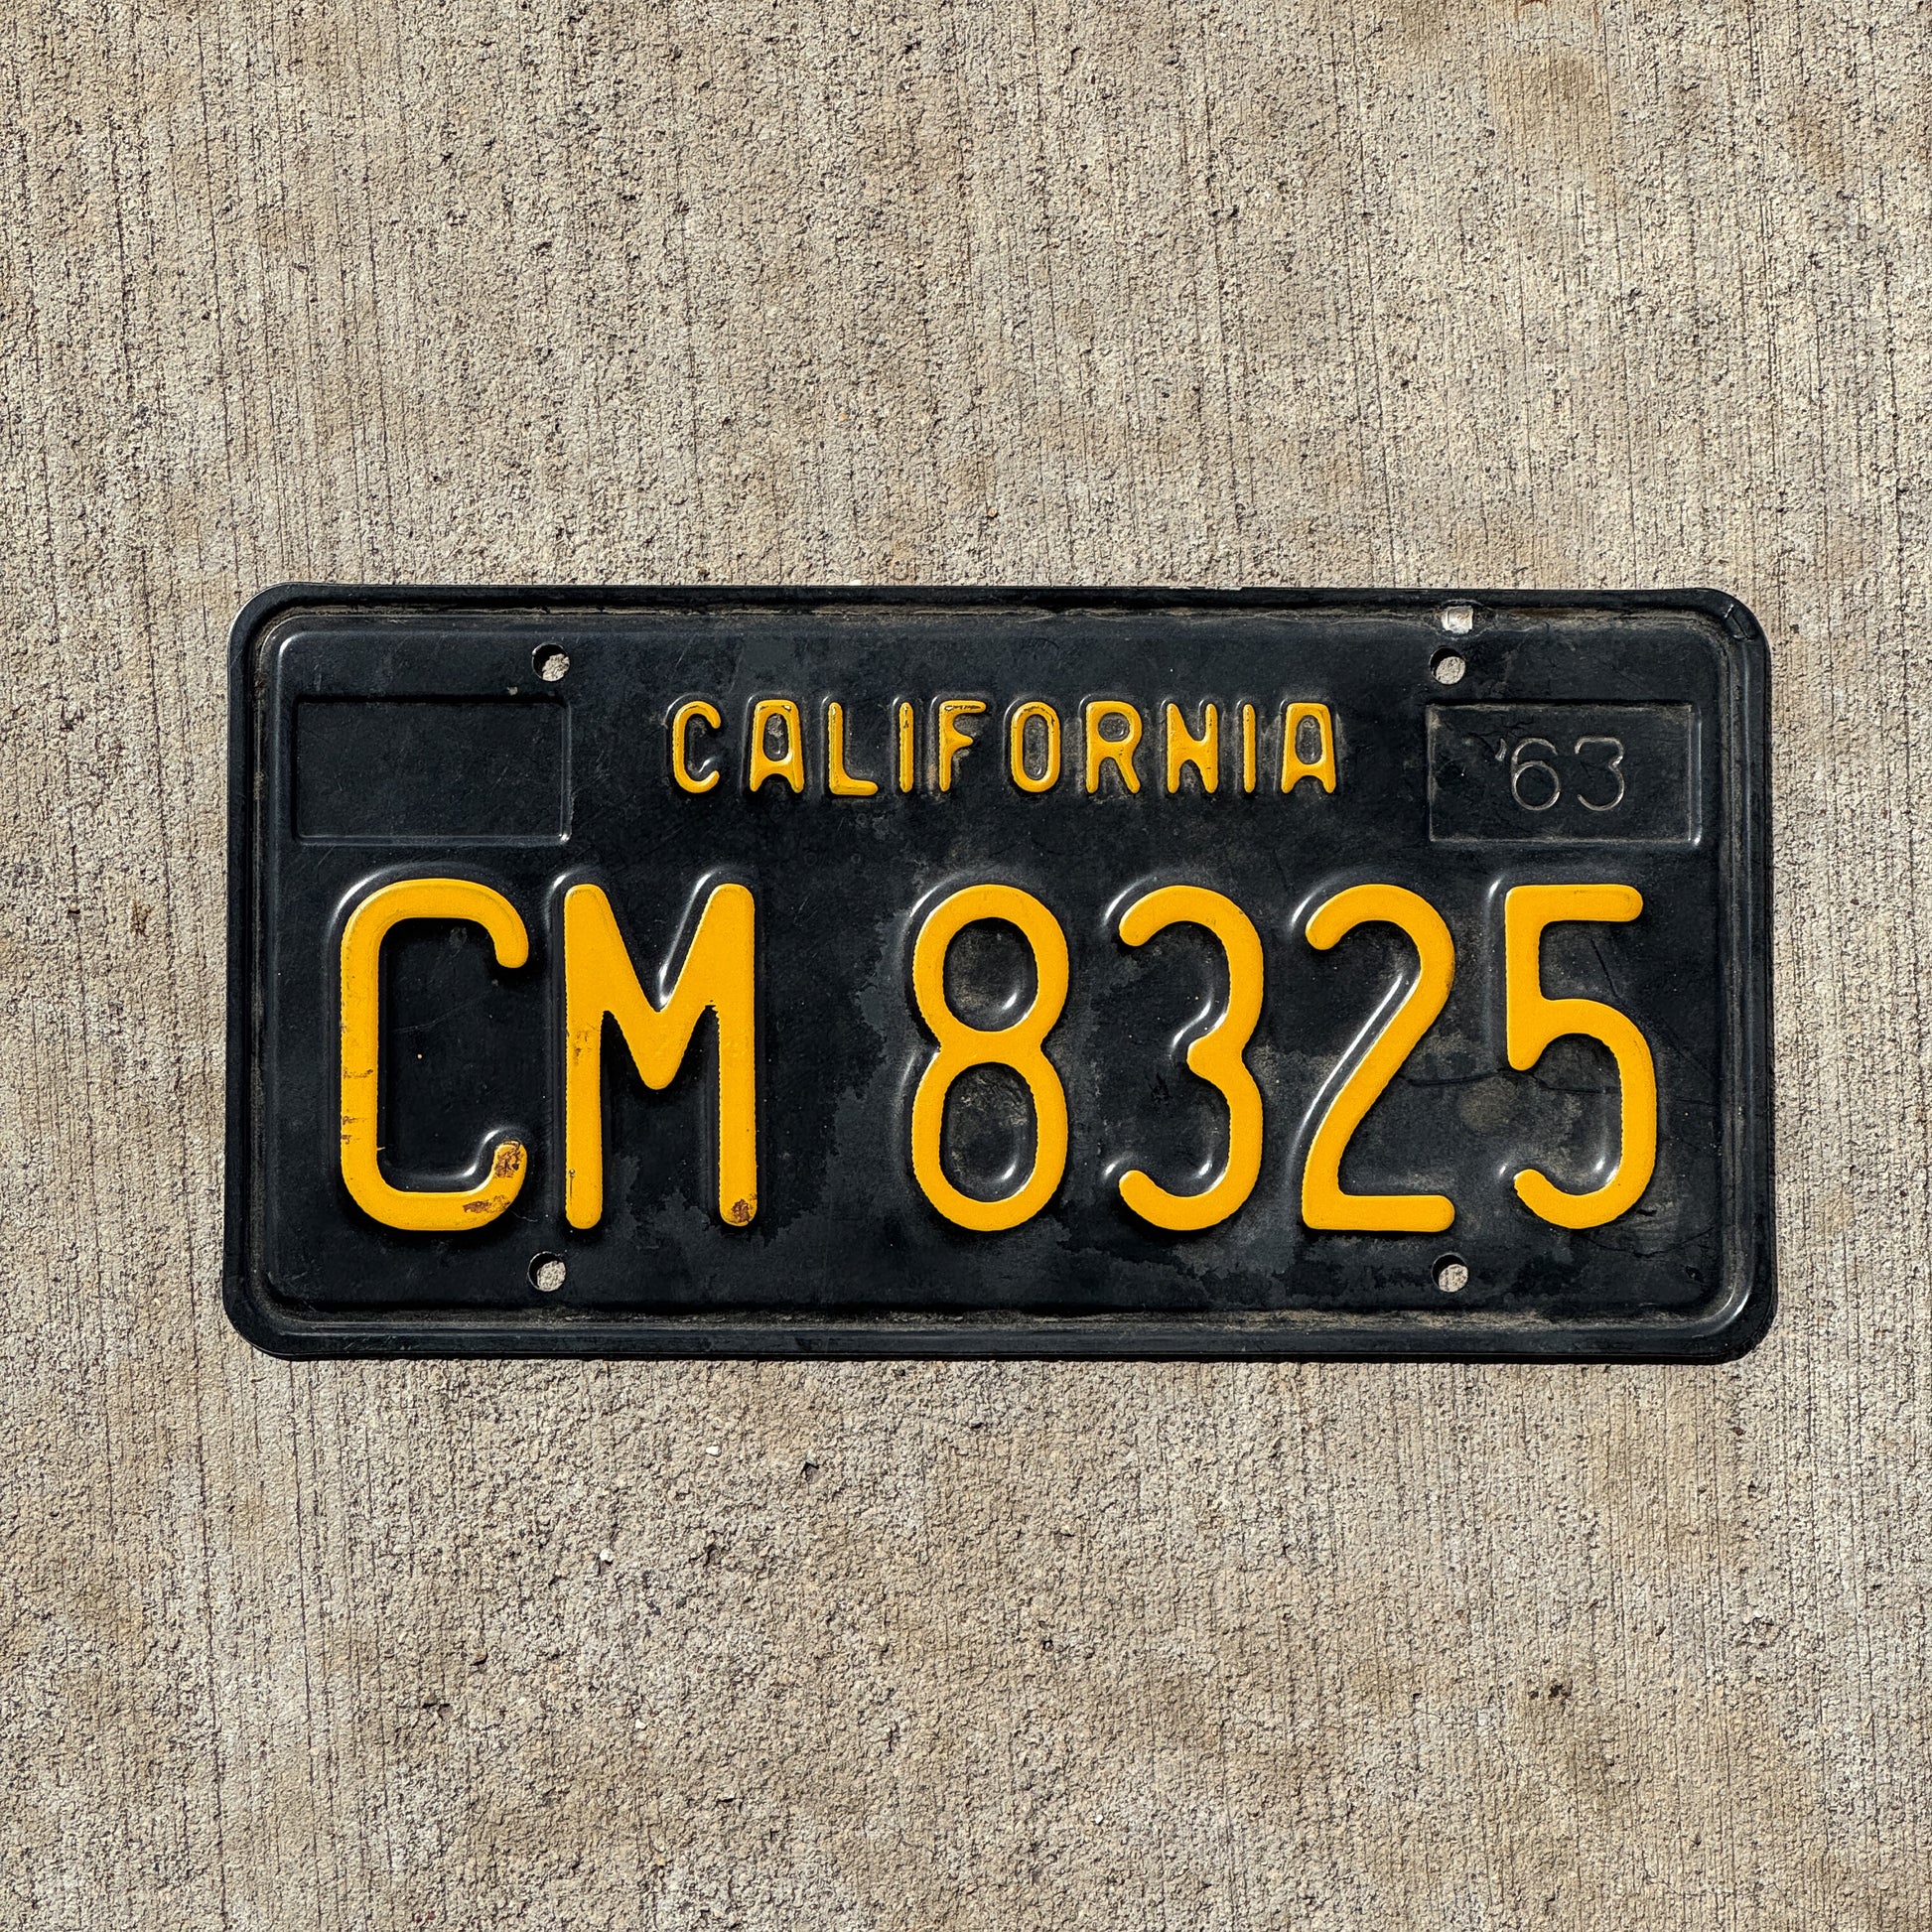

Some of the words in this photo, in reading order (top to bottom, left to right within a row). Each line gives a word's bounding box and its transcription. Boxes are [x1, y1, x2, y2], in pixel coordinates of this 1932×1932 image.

[671, 699, 1338, 797] CALIFORNIA
[339, 876, 759, 1232] CM
[910, 883, 1659, 1233] 8325
